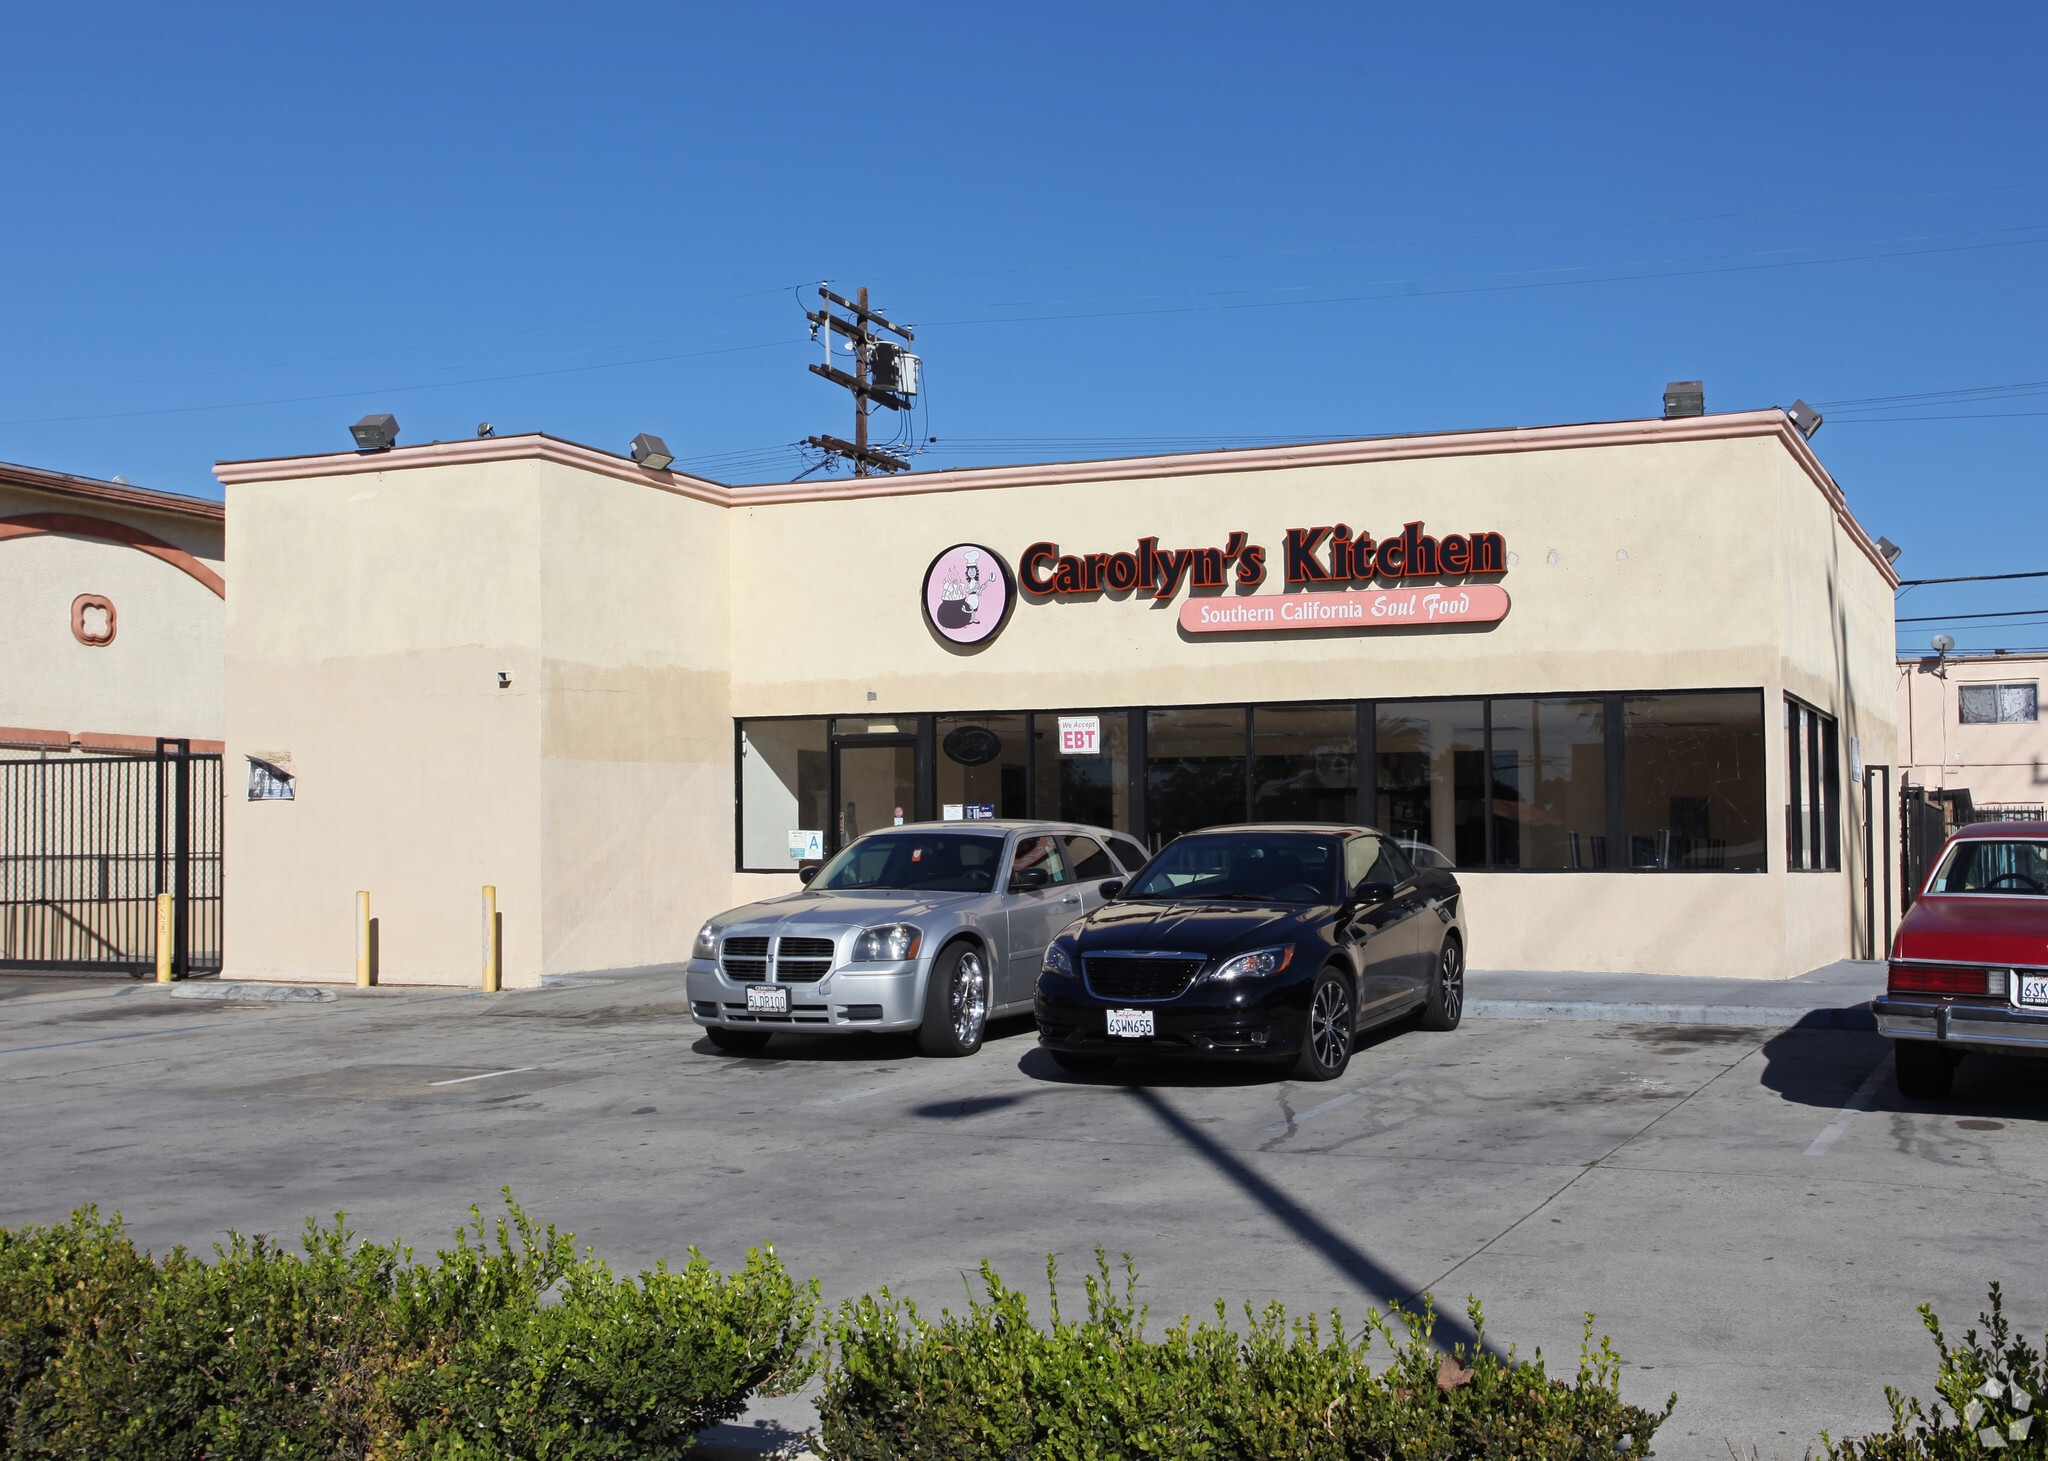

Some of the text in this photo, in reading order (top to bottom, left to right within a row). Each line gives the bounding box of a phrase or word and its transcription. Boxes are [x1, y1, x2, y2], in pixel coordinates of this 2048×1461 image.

[1019, 520, 1506, 599] Carolyn's Kitchen
[1200, 593, 1470, 624] Southern California Soul Food
[1062, 721, 1096, 730] We Accept
[1063, 730, 1096, 749] EBT
[809, 835, 819, 849] A
[748, 995, 785, 1008] 5LDR100
[1109, 1018, 1152, 1033] 6SWN655
